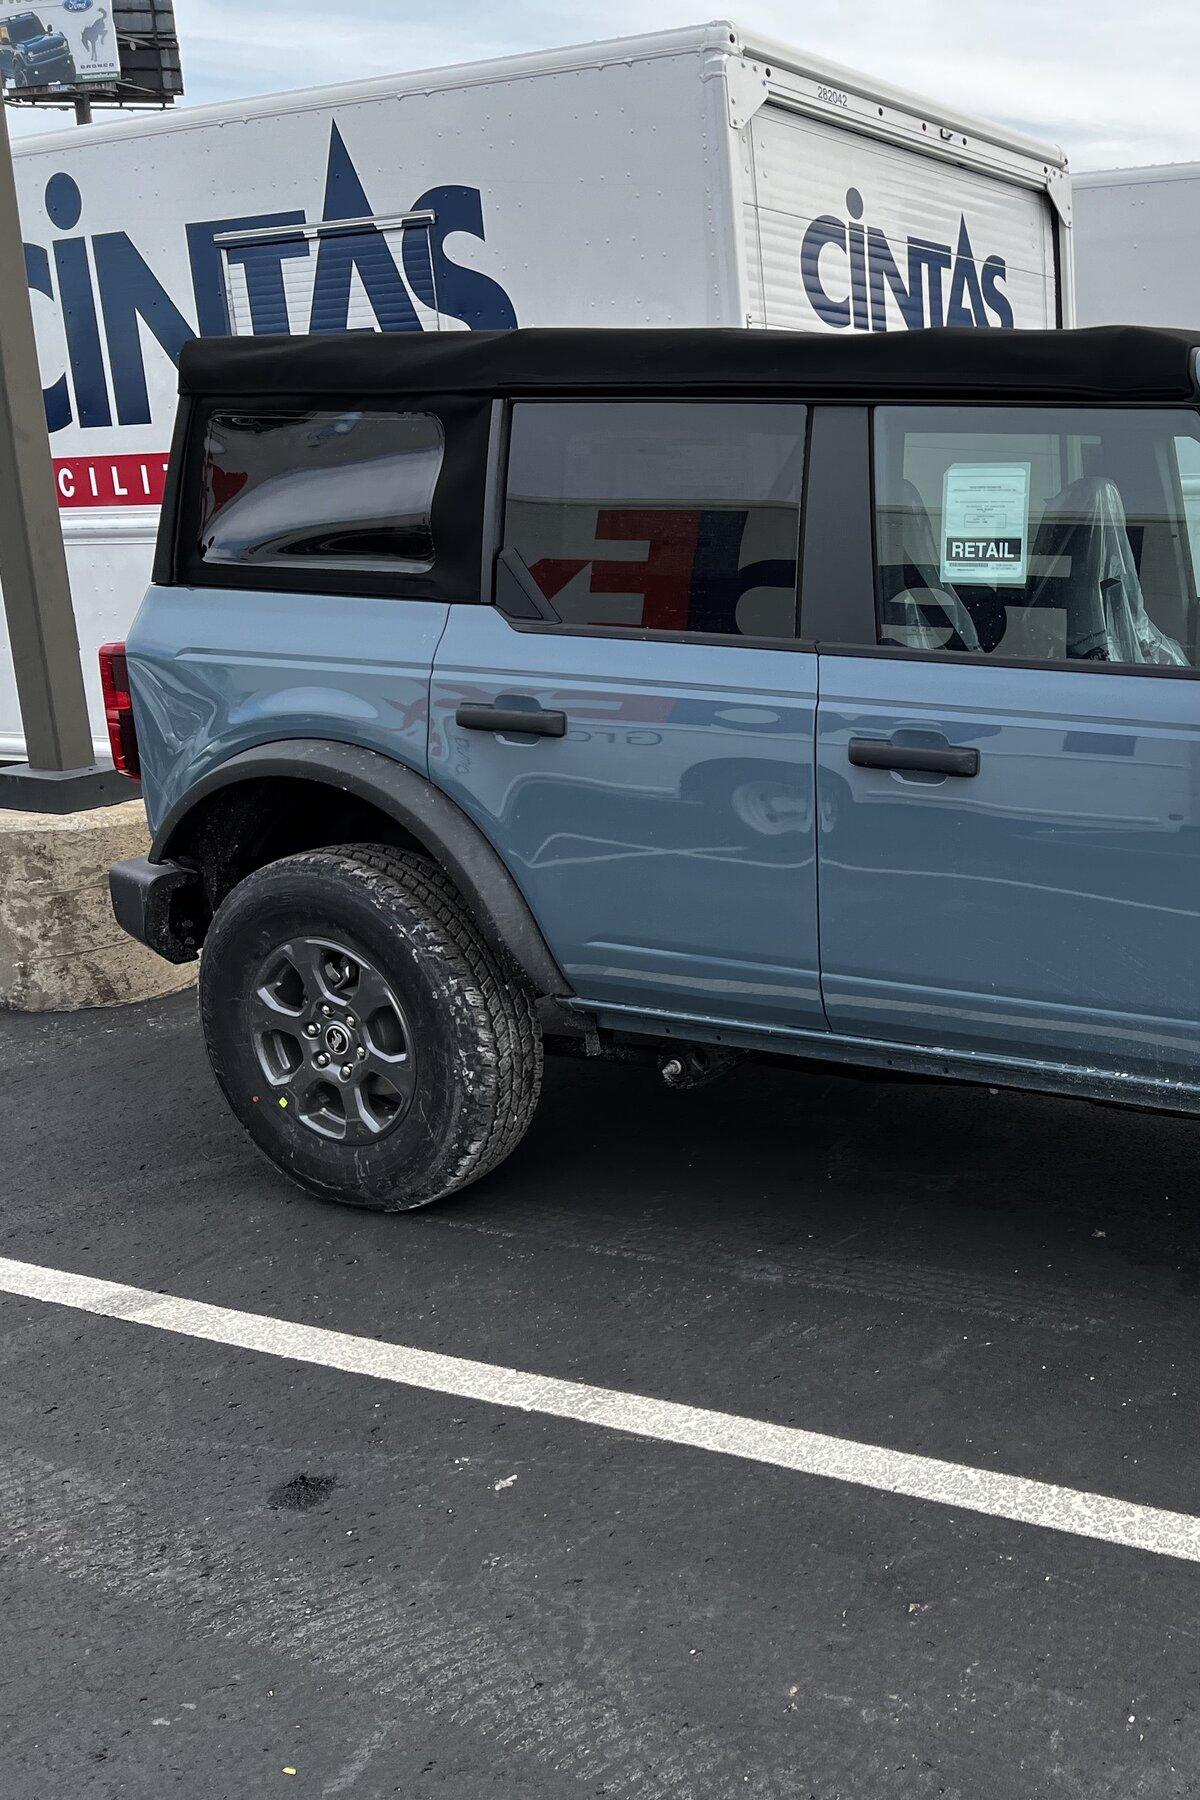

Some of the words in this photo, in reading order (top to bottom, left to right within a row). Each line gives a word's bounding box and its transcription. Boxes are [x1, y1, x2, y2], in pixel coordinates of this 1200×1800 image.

[817, 86, 848, 107] 282042
[57, 463, 169, 498] CILI
[951, 541, 1015, 558] RETAIL
